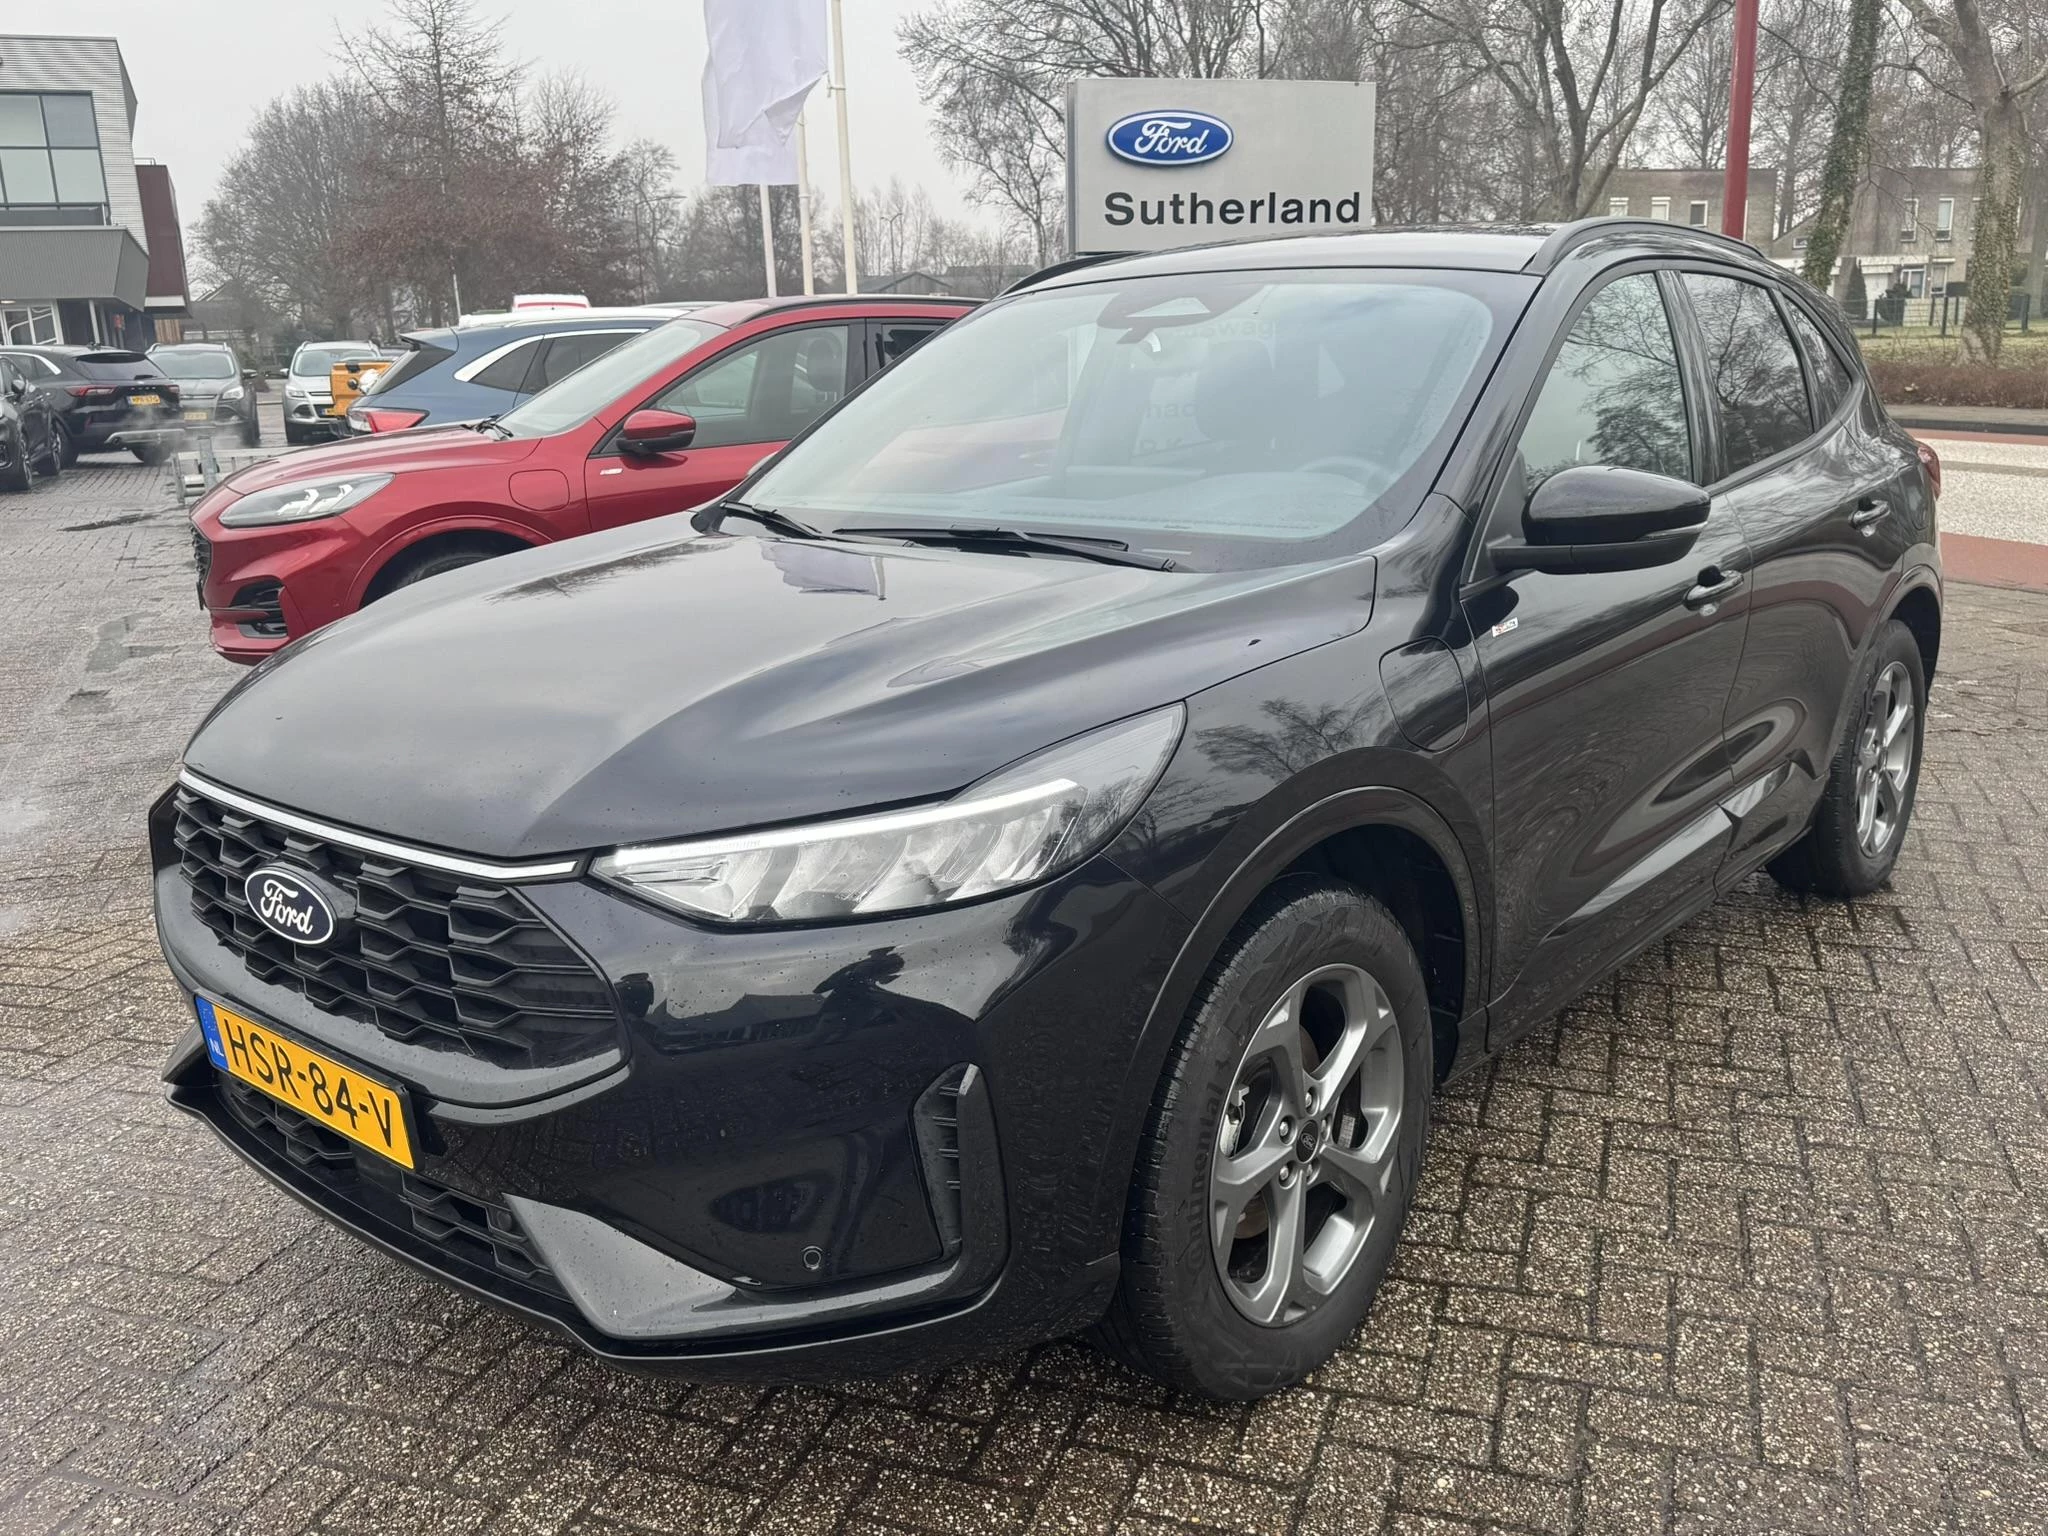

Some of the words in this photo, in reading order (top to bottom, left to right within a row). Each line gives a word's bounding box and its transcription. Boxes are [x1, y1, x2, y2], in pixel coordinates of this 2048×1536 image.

[1134, 119, 1210, 154] Ford
[1104, 191, 1360, 226] Sutherland
[259, 878, 313, 935] Ford
[223, 1017, 393, 1149] HSR-84-V
